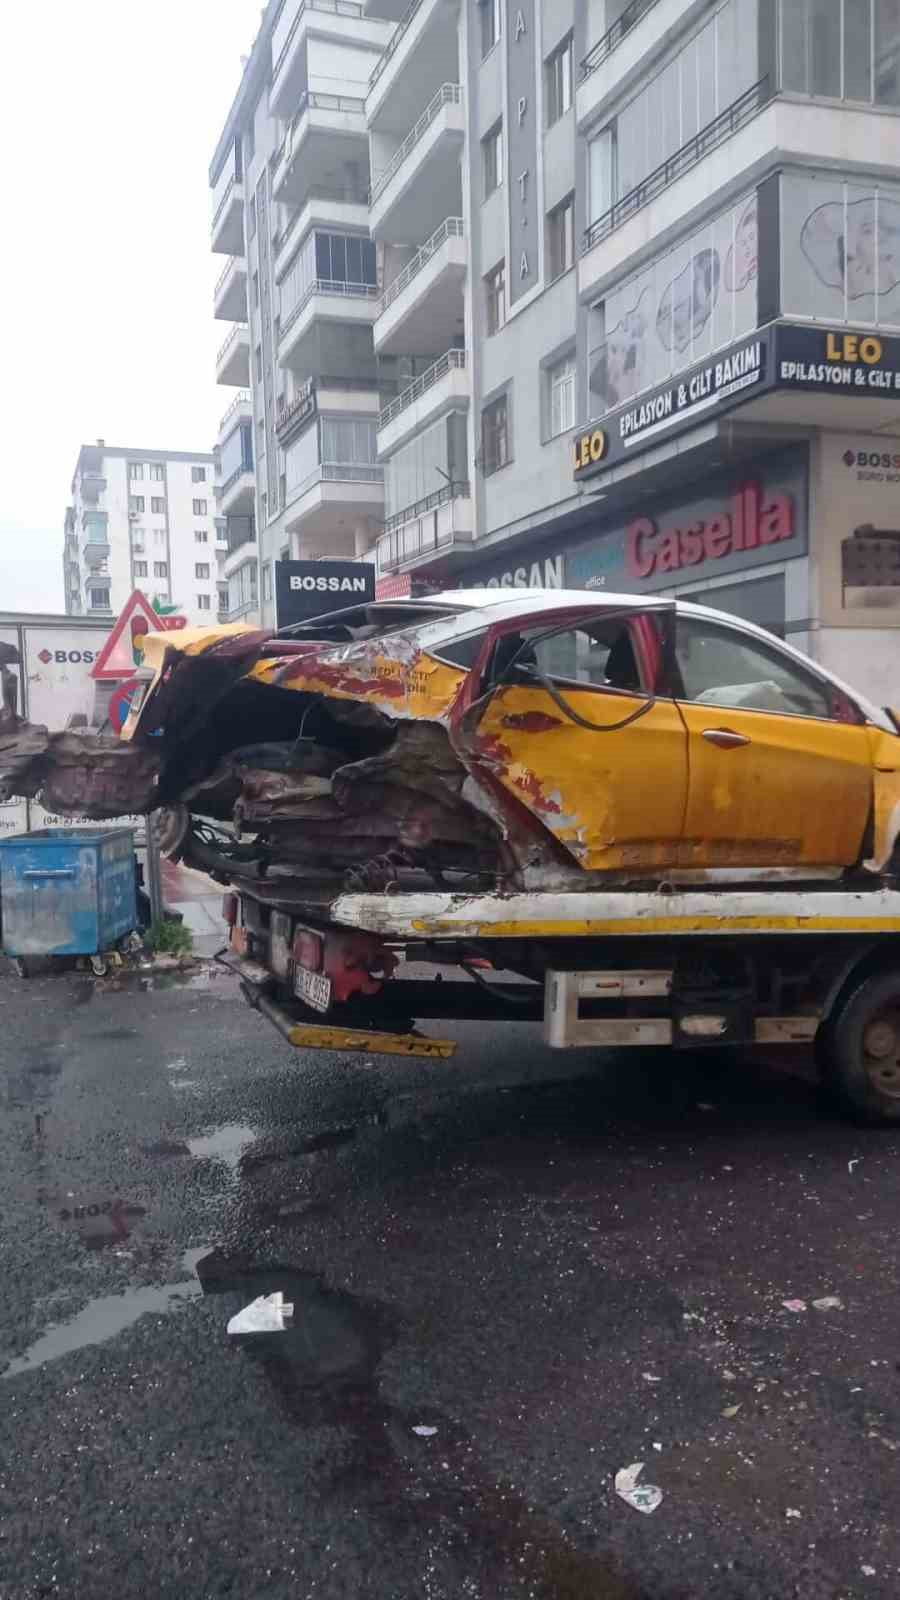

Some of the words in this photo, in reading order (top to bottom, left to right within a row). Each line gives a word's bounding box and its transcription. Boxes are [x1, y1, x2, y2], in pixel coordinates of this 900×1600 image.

[826, 333, 882, 365] LEO
[677, 384, 689, 409] &
[715, 341, 761, 388] BAKIMI
[855, 368, 866, 386] &
[624, 481, 796, 578] Casella
[289, 575, 366, 592] BOSSAN
[472, 554, 564, 590] SSAN
